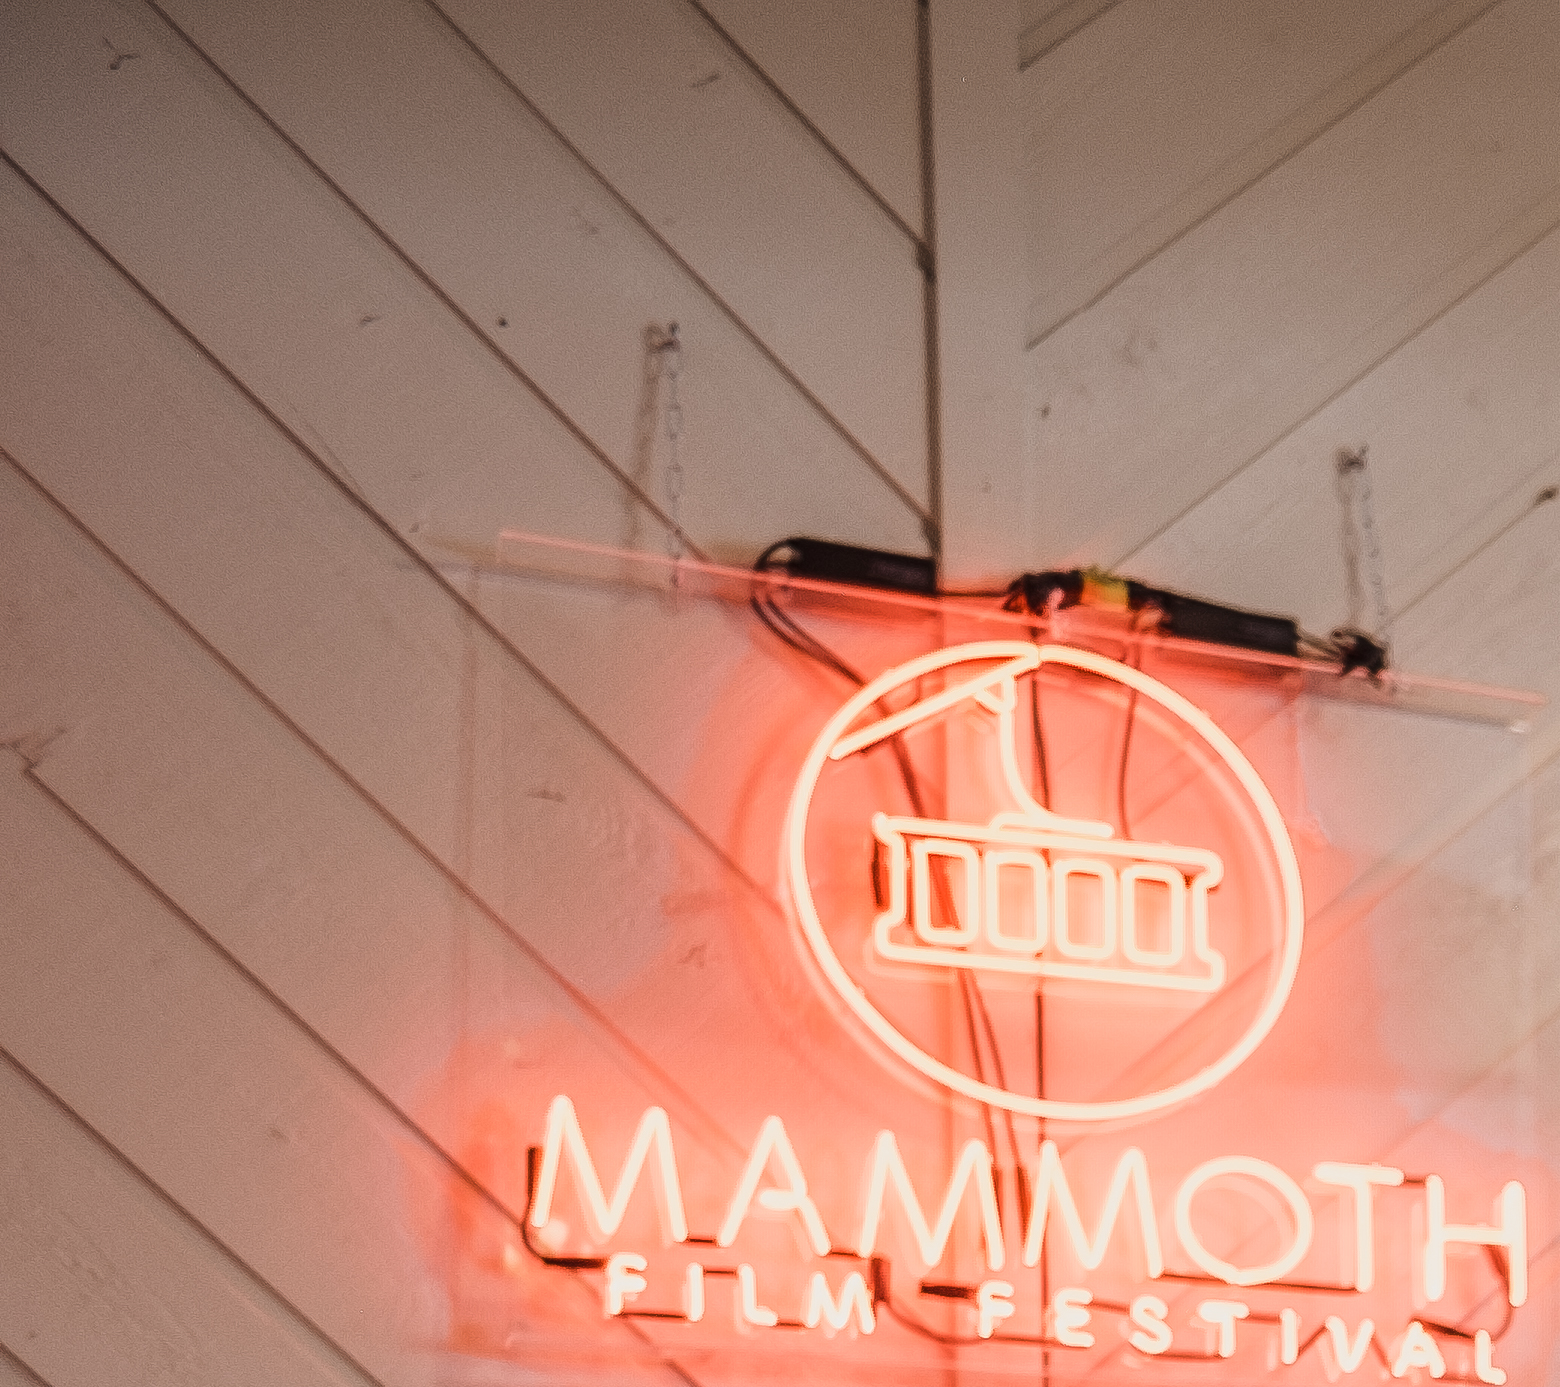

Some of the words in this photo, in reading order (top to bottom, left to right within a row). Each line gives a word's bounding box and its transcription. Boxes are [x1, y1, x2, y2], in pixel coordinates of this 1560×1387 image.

[532, 1094, 1528, 1309] MAMMOTH
[606, 1252, 876, 1335] FILM
[976, 1280, 1508, 1386] FESTIVAL
